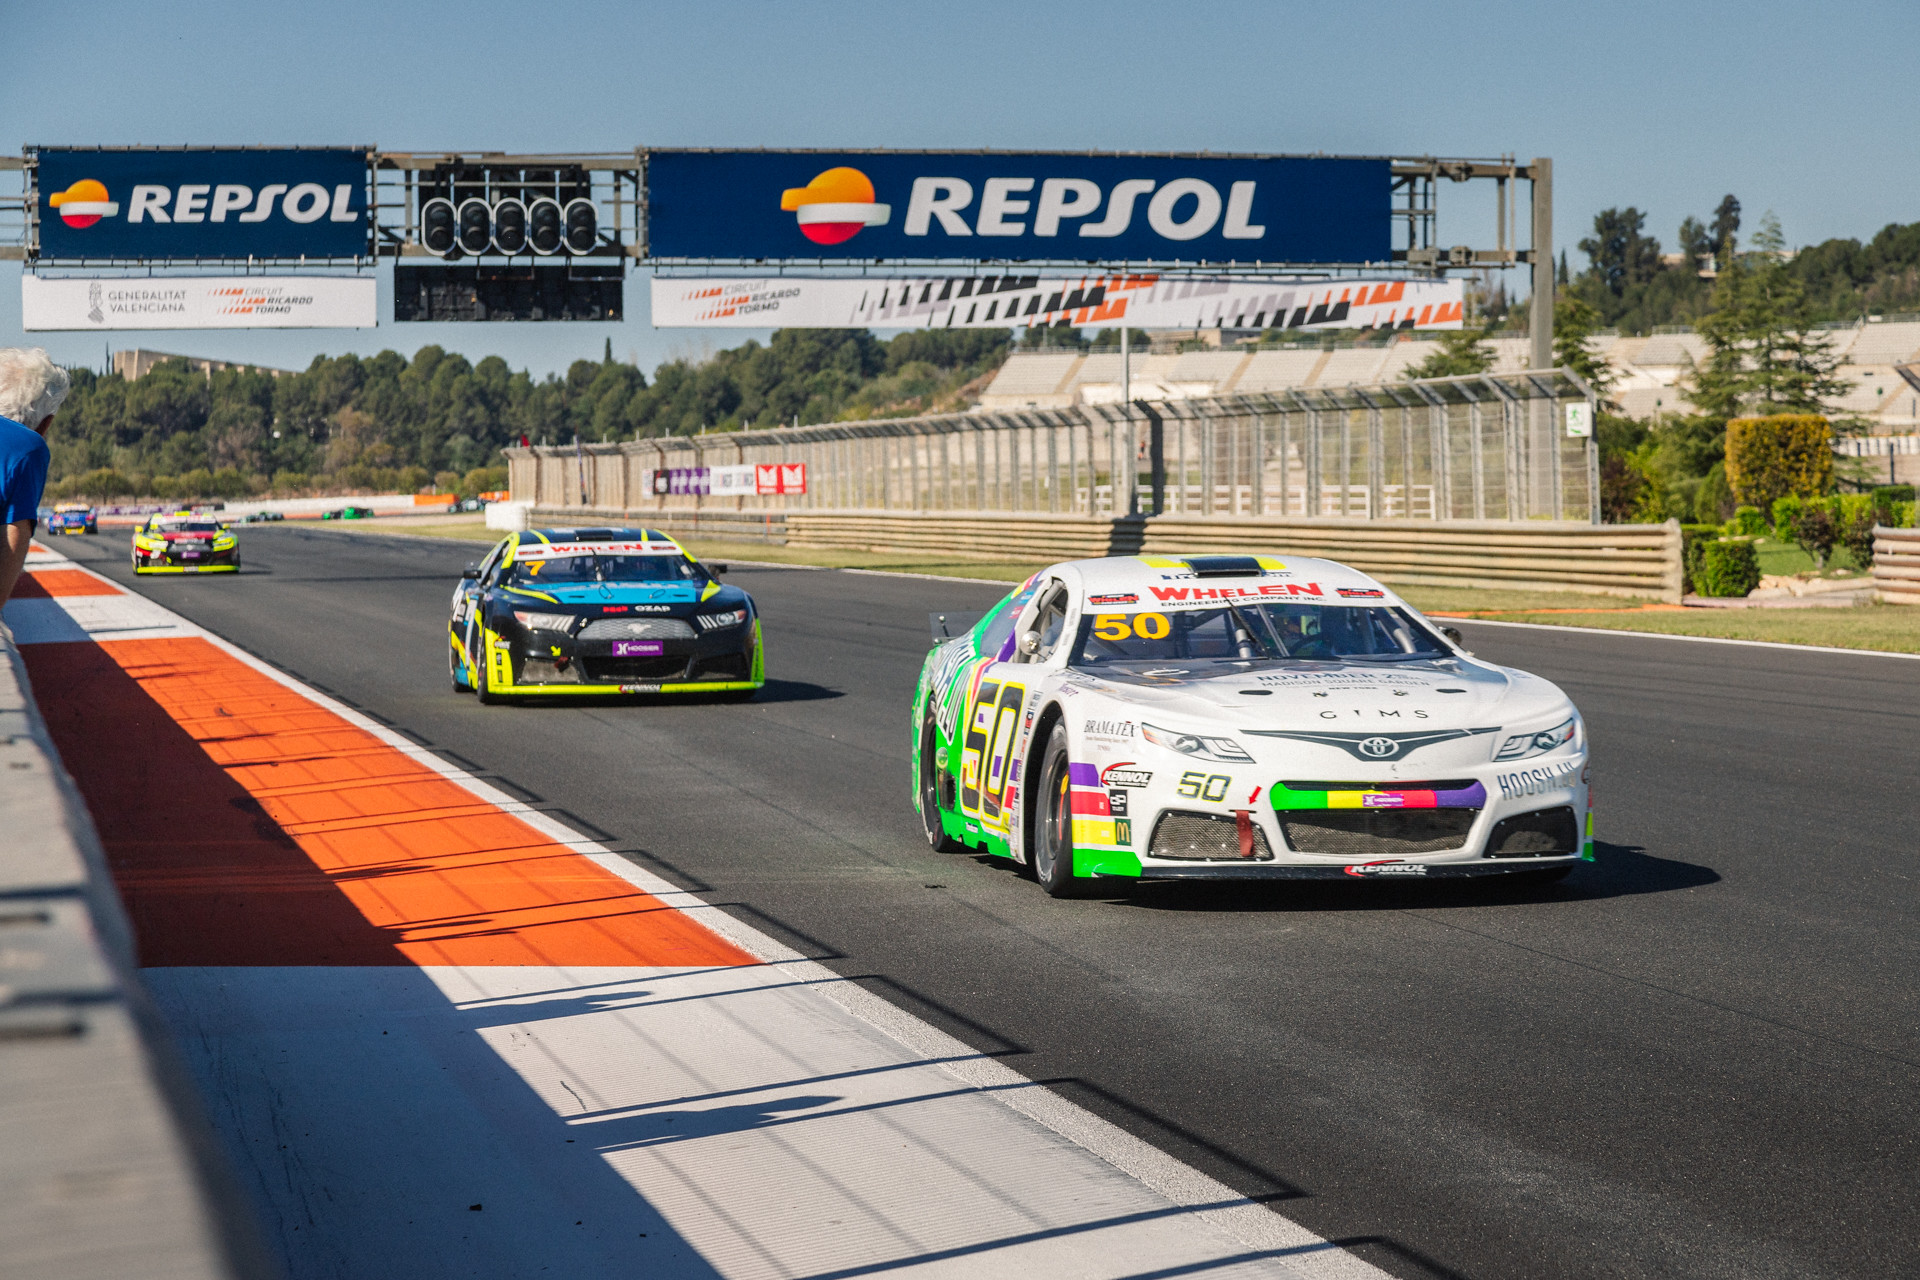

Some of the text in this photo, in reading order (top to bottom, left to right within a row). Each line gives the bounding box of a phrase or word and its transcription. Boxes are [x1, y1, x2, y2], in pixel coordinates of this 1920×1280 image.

[127, 182, 359, 224] REPSOL
[904, 176, 1266, 241] REPSOL
[245, 286, 284, 296] CIRCUIT
[724, 280, 768, 296] CIRCUIT
[752, 287, 801, 302] RICARDO
[108, 290, 187, 301] GENERALITAT
[267, 296, 314, 305] RICARDO
[110, 303, 186, 313] VALENCIANA
[255, 305, 292, 315] TORMO
[738, 301, 780, 315] TORMO
[524, 560, 546, 576] 7
[1147, 582, 1325, 601] WHELEN
[1160, 596, 1240, 607] ENGINEERING
[1094, 611, 1171, 641] 50
[1256, 672, 1378, 681] NOVEMBER
[1262, 677, 1431, 688] MADISON SQUARE GARDEN
[960, 678, 1025, 821] 50
[1103, 770, 1152, 784] KENNOL
[1176, 770, 1233, 803] 50
[1350, 864, 1428, 873] KENNOL
